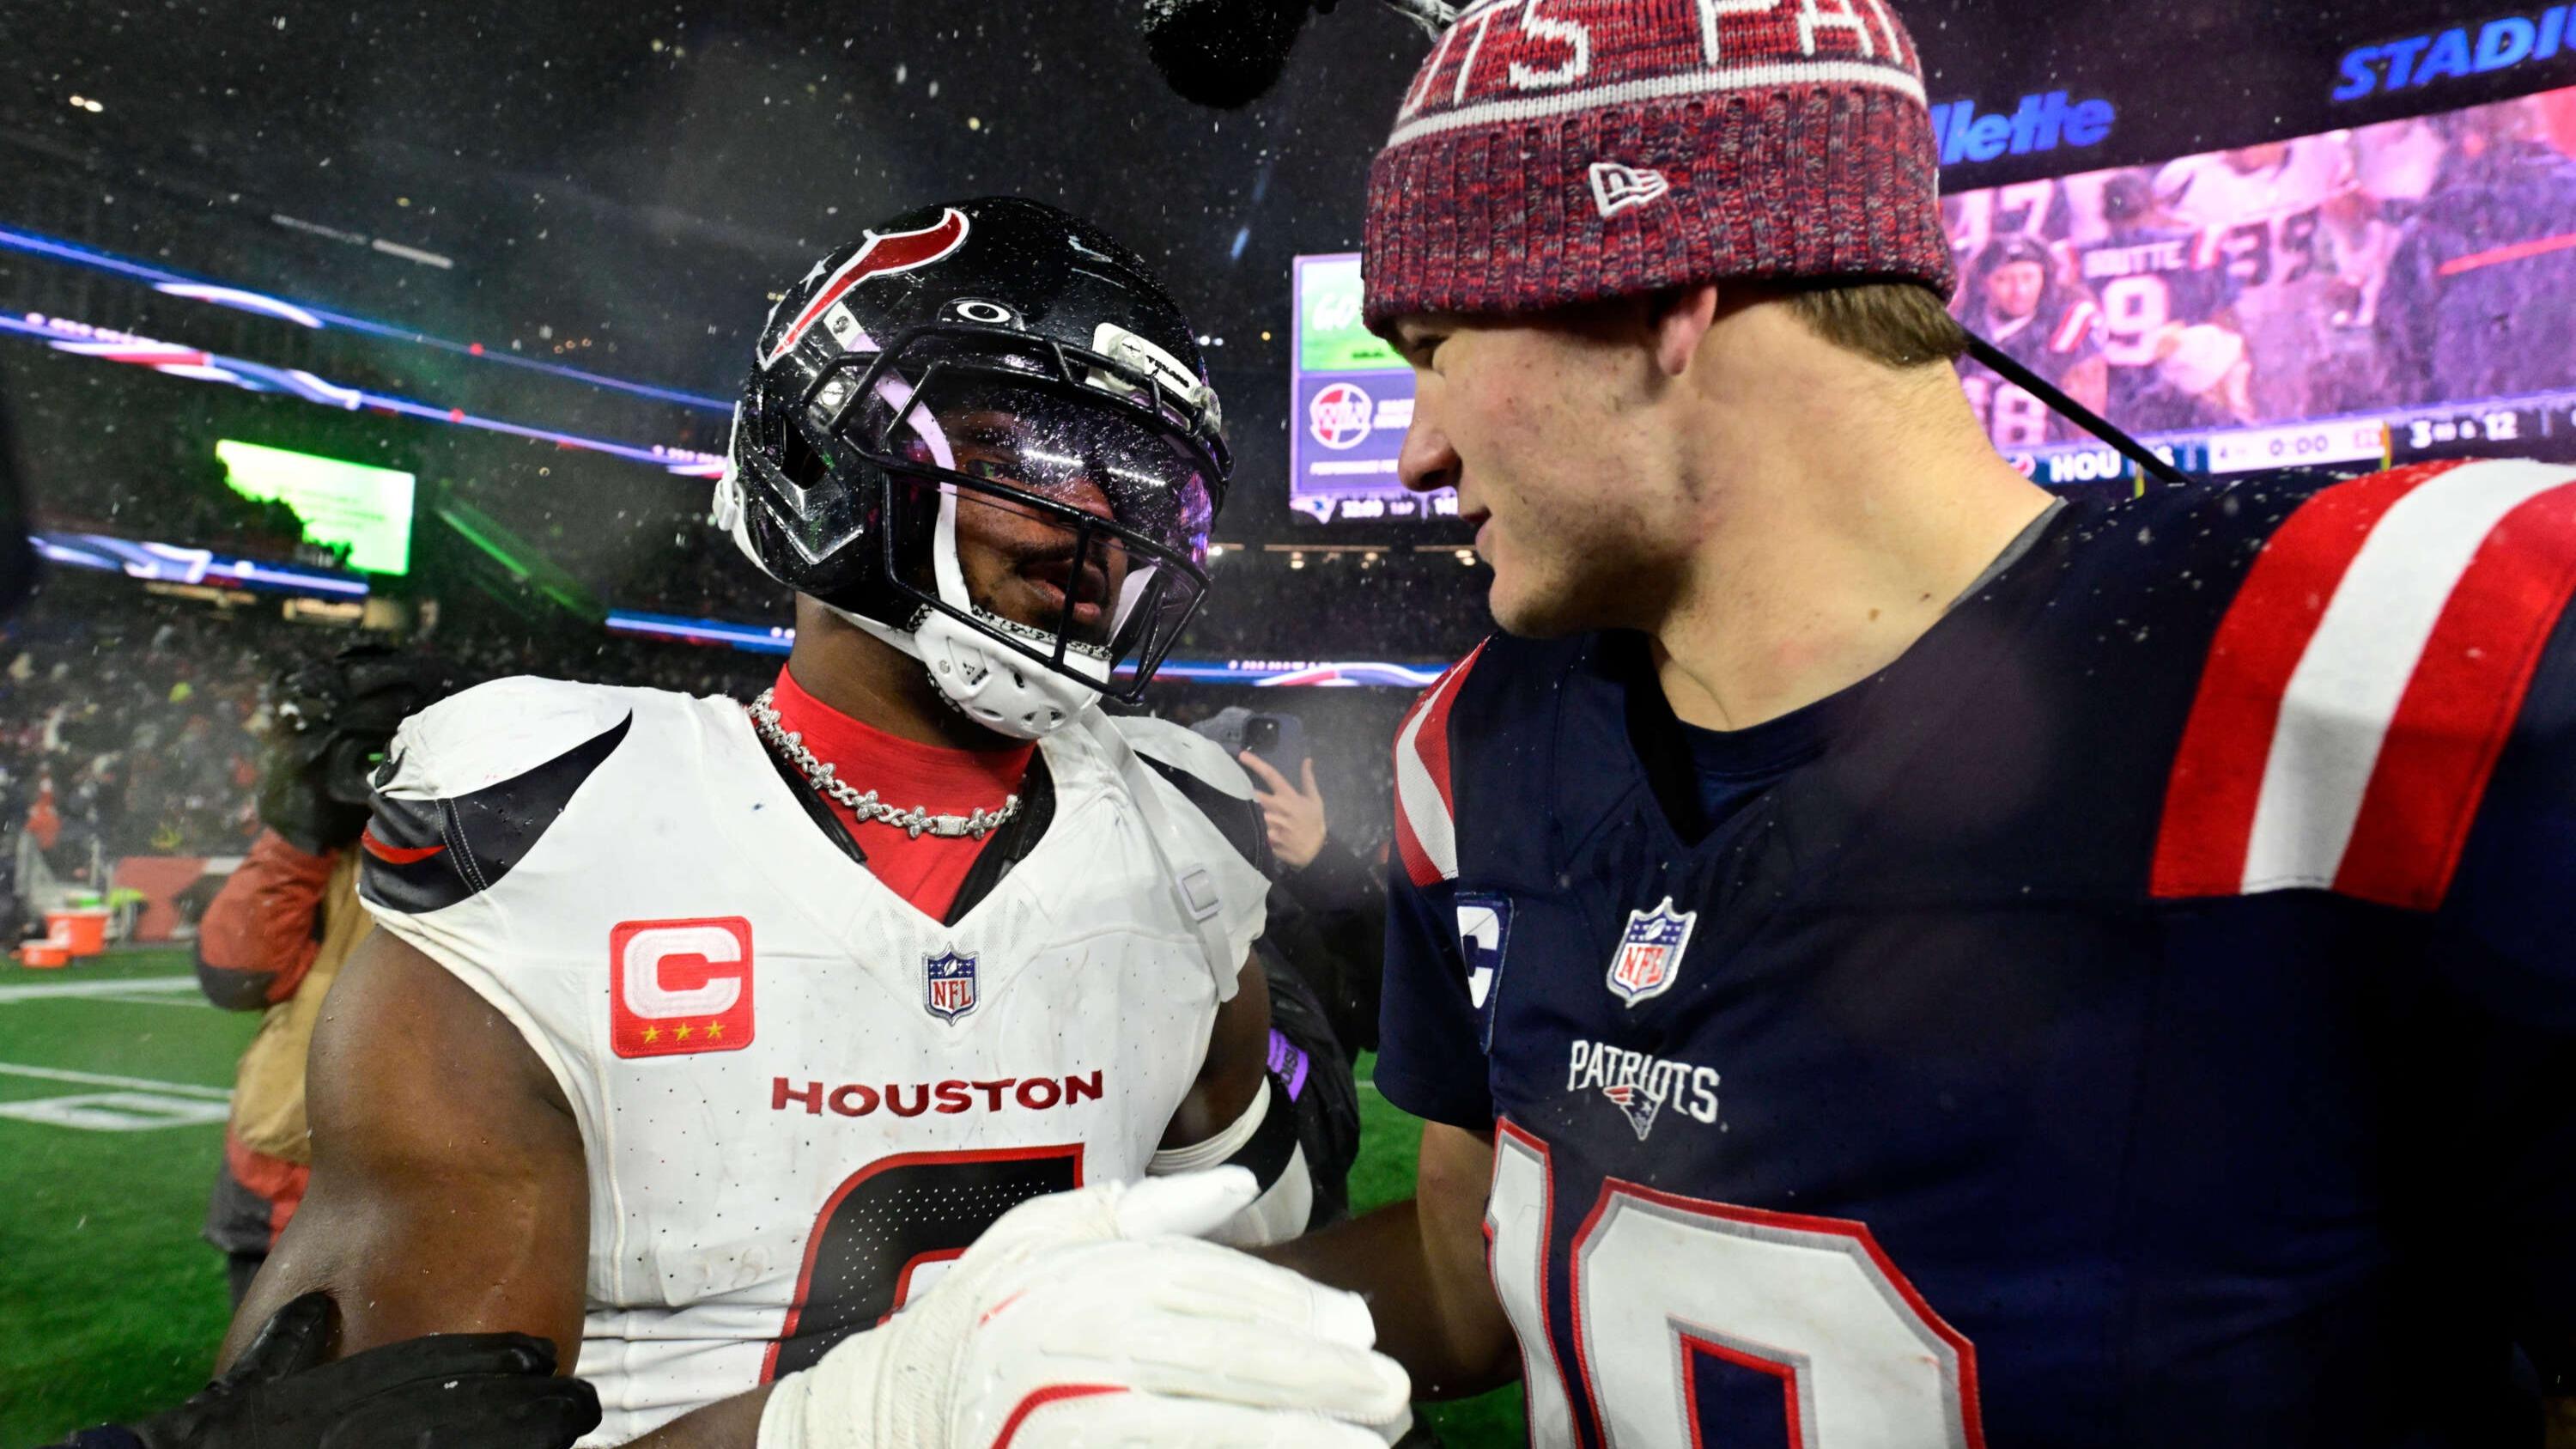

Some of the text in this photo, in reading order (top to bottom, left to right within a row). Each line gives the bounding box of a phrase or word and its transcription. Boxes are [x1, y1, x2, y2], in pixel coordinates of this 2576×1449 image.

[2334, 3, 2576, 101] STADI
[2103, 274, 2167, 365] 9
[2050, 448, 2122, 483] HOU
[623, 926, 742, 1020] C
[933, 979, 972, 1011] NFL
[1456, 906, 1500, 1009] C
[1619, 947, 1665, 986] NFL
[771, 1069, 1103, 1117] HOUSTON
[1566, 1039, 1721, 1123] PATRIOTS
